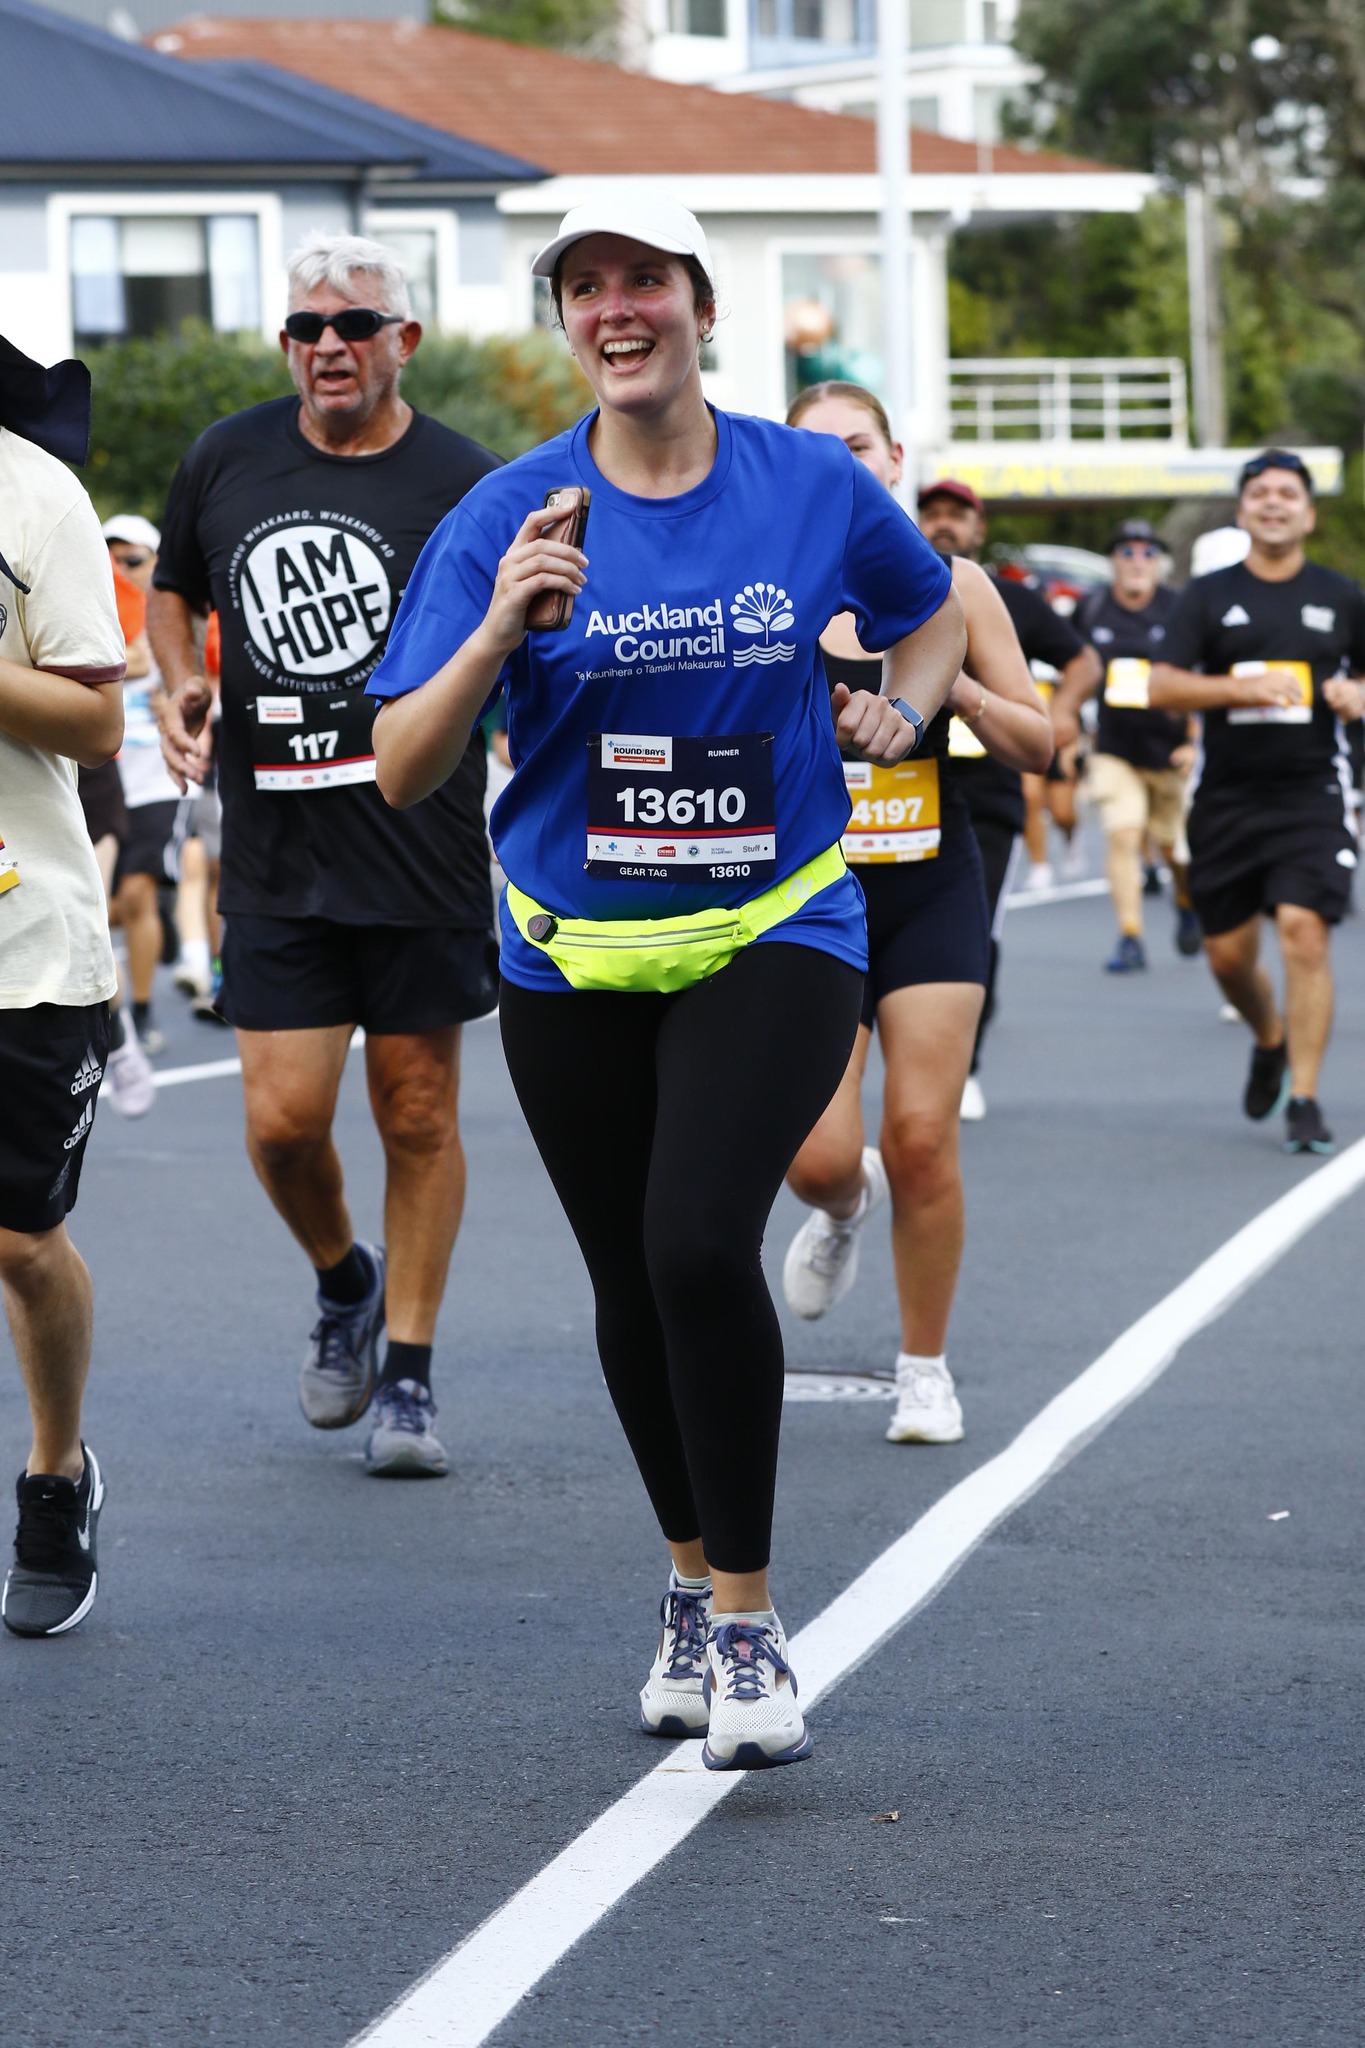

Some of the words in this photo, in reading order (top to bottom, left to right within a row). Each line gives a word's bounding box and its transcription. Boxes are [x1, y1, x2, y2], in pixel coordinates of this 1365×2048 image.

[320, 510, 383, 543] WHAKAHOU
[241, 561, 265, 614] I
[275, 532, 357, 605] AM
[261, 583, 383, 665] HOPE
[585, 599, 724, 638] Auckland
[614, 627, 726, 663] Council
[575, 671, 585, 681] Te
[586, 667, 633, 681] Kaunihera
[678, 660, 726, 671] Makaurau
[288, 729, 340, 761] 117
[613, 747, 642, 755] ROUND
[644, 748, 666, 757] BAYS
[708, 749, 740, 757] RUNNER
[616, 786, 746, 825] 13610
[742, 844, 760, 853] Stuff
[619, 866, 646, 877] GEAR
[647, 868, 668, 878] TAG
[709, 864, 751, 878] 13610
[70, 1067, 103, 1096] adidas
